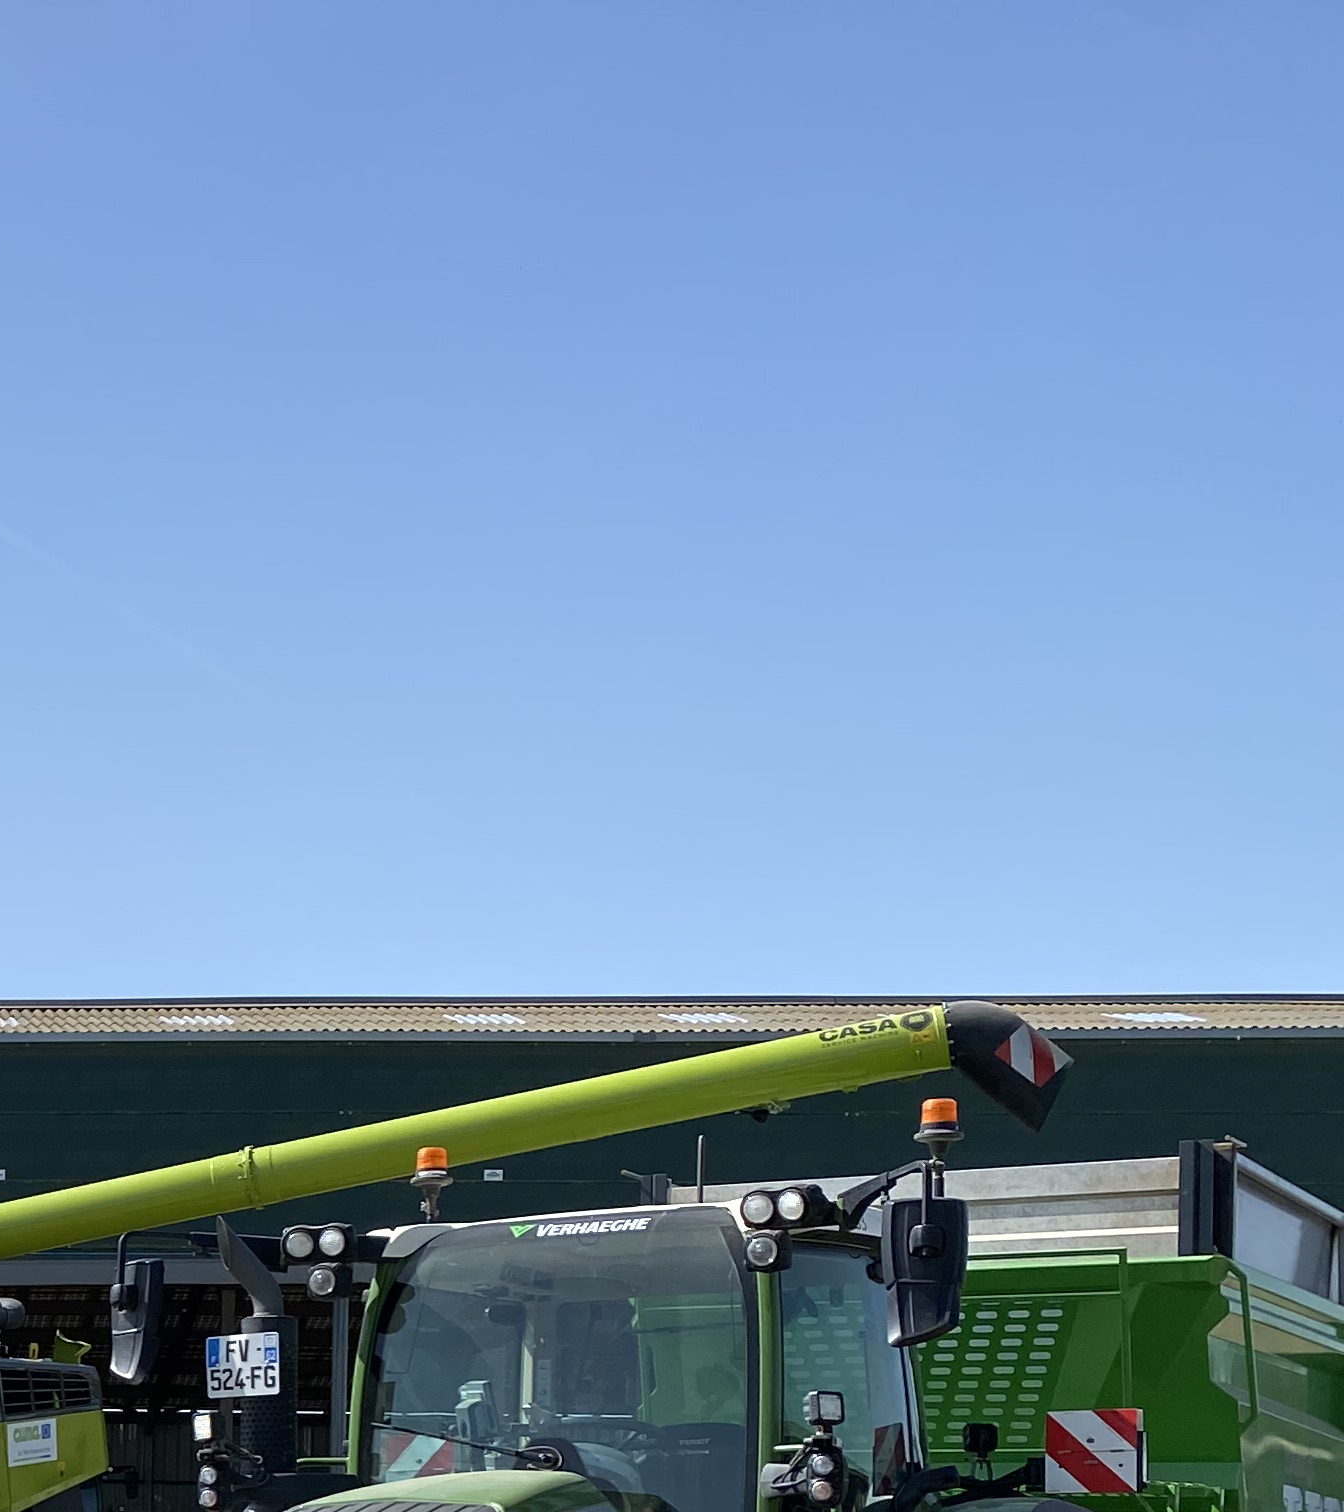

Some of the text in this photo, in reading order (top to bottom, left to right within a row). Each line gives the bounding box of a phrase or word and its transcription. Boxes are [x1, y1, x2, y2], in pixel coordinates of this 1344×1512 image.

[819, 1019, 897, 1042] CASA
[536, 1217, 651, 1237] VERHAEGHE
[210, 1365, 276, 1391] 524-FG
